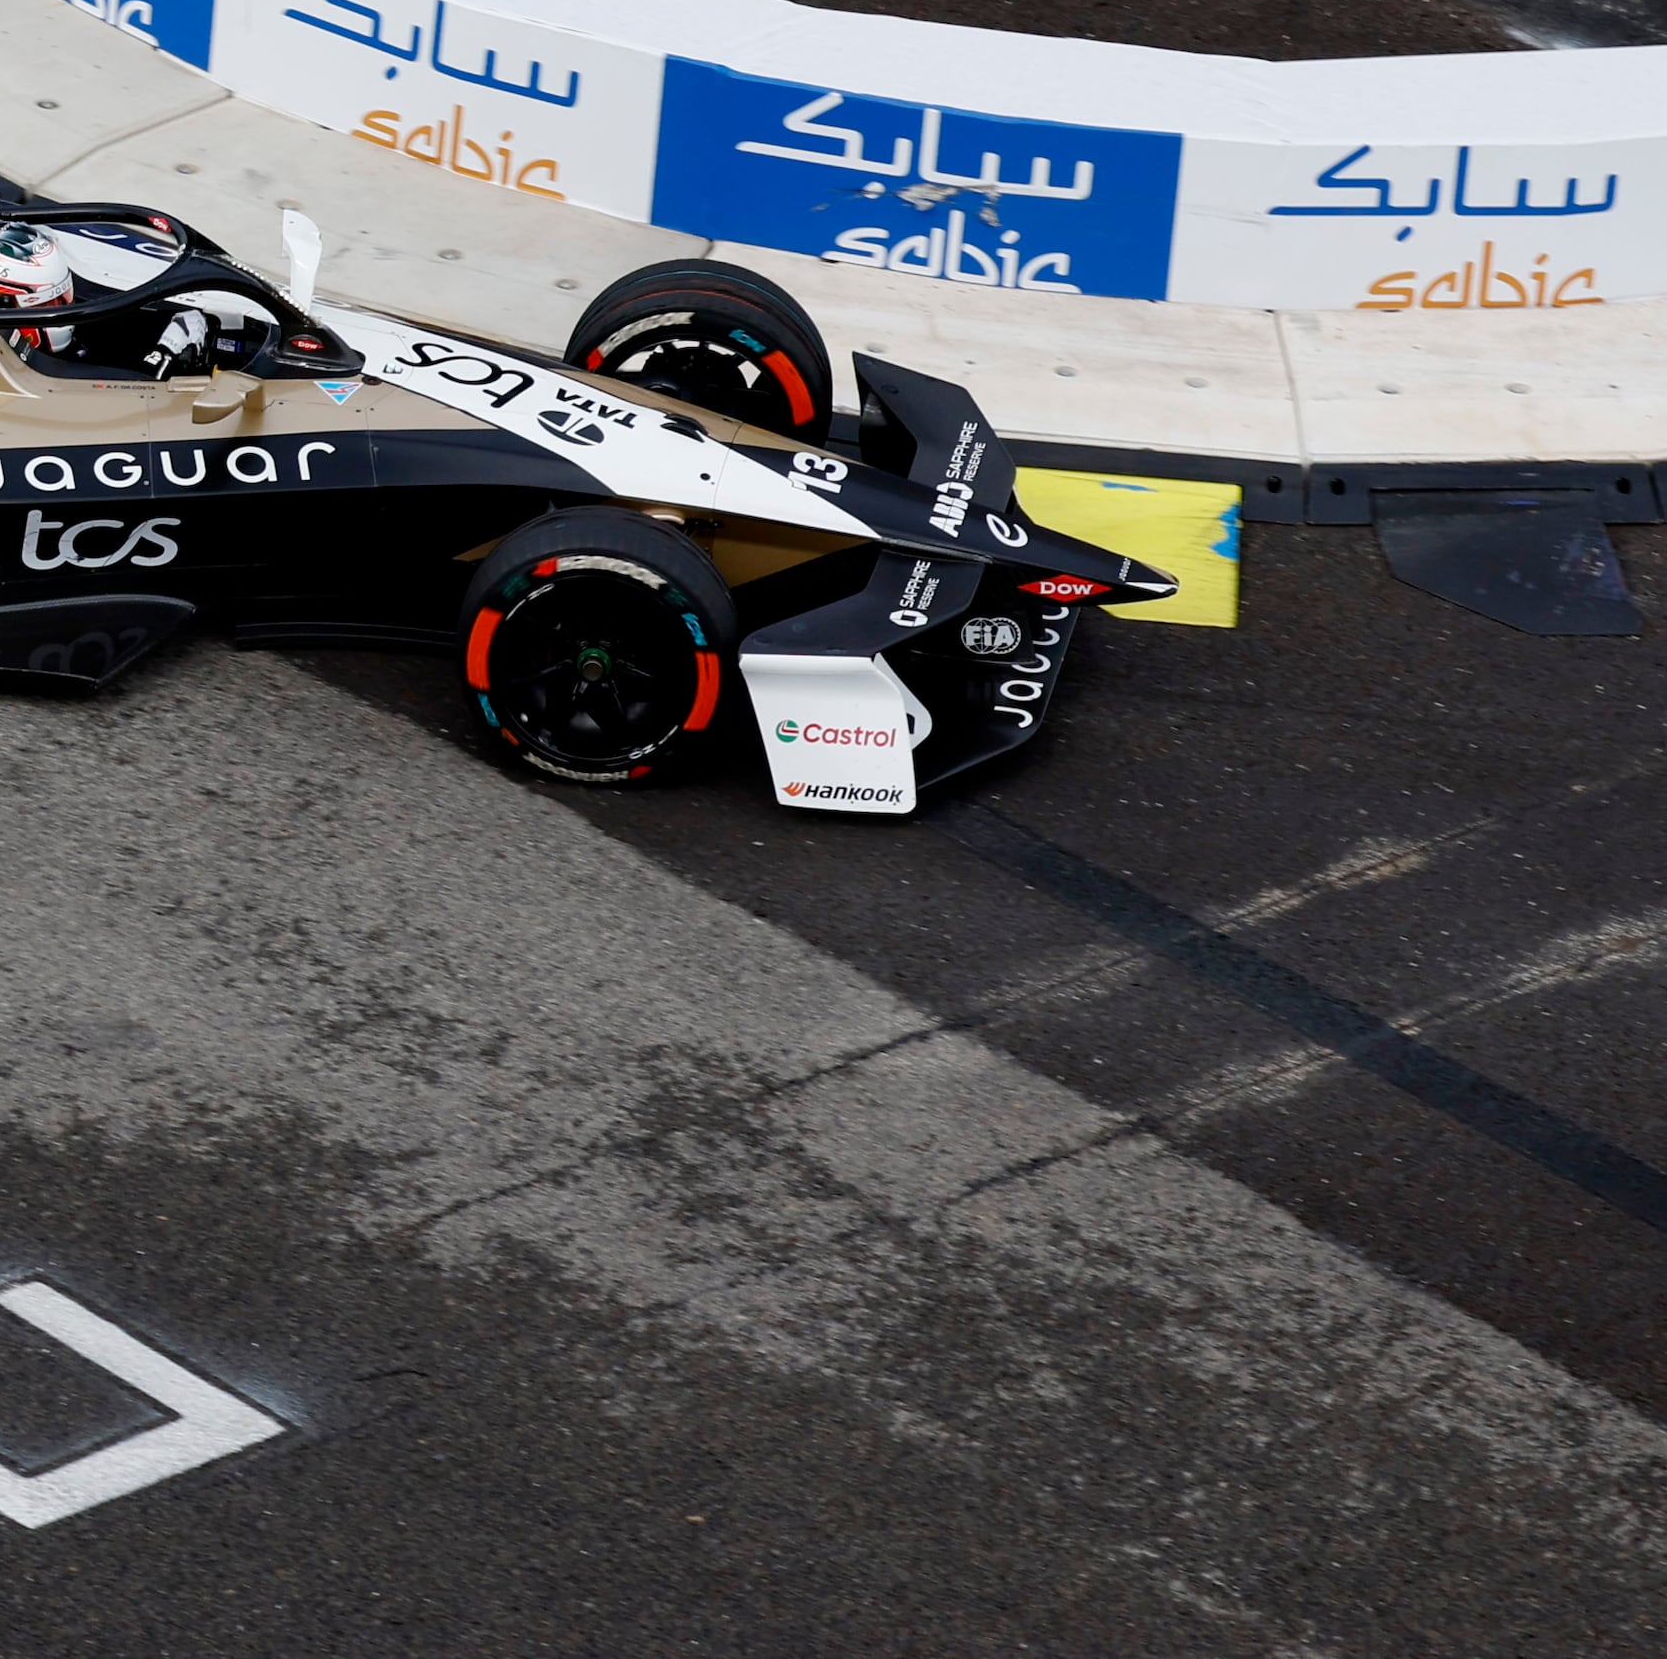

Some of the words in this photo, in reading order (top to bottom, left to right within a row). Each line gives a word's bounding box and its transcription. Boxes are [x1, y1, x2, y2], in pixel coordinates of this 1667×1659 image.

[351, 105, 565, 201] sabic
[736, 92, 1094, 200] سابك
[1268, 145, 1618, 242] سابك
[825, 209, 1080, 295] sabic
[1356, 241, 1604, 309] sabic
[555, 388, 638, 430] TATA
[787, 451, 851, 497] 13
[945, 420, 979, 480] SAPPHIRE
[962, 440, 987, 482] RESERVE
[20, 509, 183, 568] tcs
[899, 559, 932, 609] SAPPHIRE
[917, 576, 941, 611] RESERVE
[802, 722, 897, 749] Castrol
